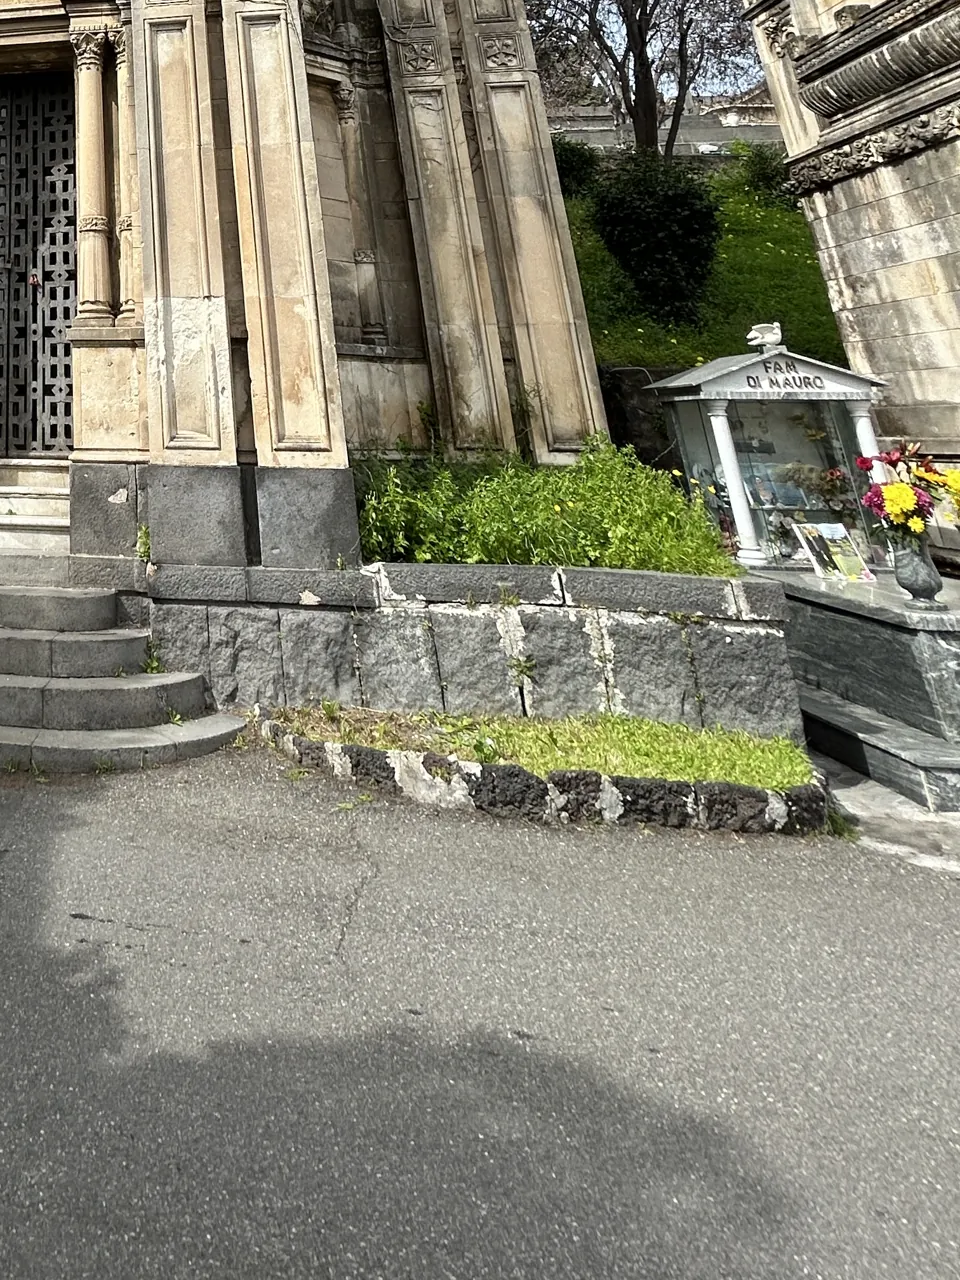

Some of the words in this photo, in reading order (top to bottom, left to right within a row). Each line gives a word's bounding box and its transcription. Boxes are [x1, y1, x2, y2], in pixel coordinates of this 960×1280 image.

[763, 360, 799, 375] FAM
[746, 375, 762, 389] DI
[768, 375, 825, 390] MAURO
